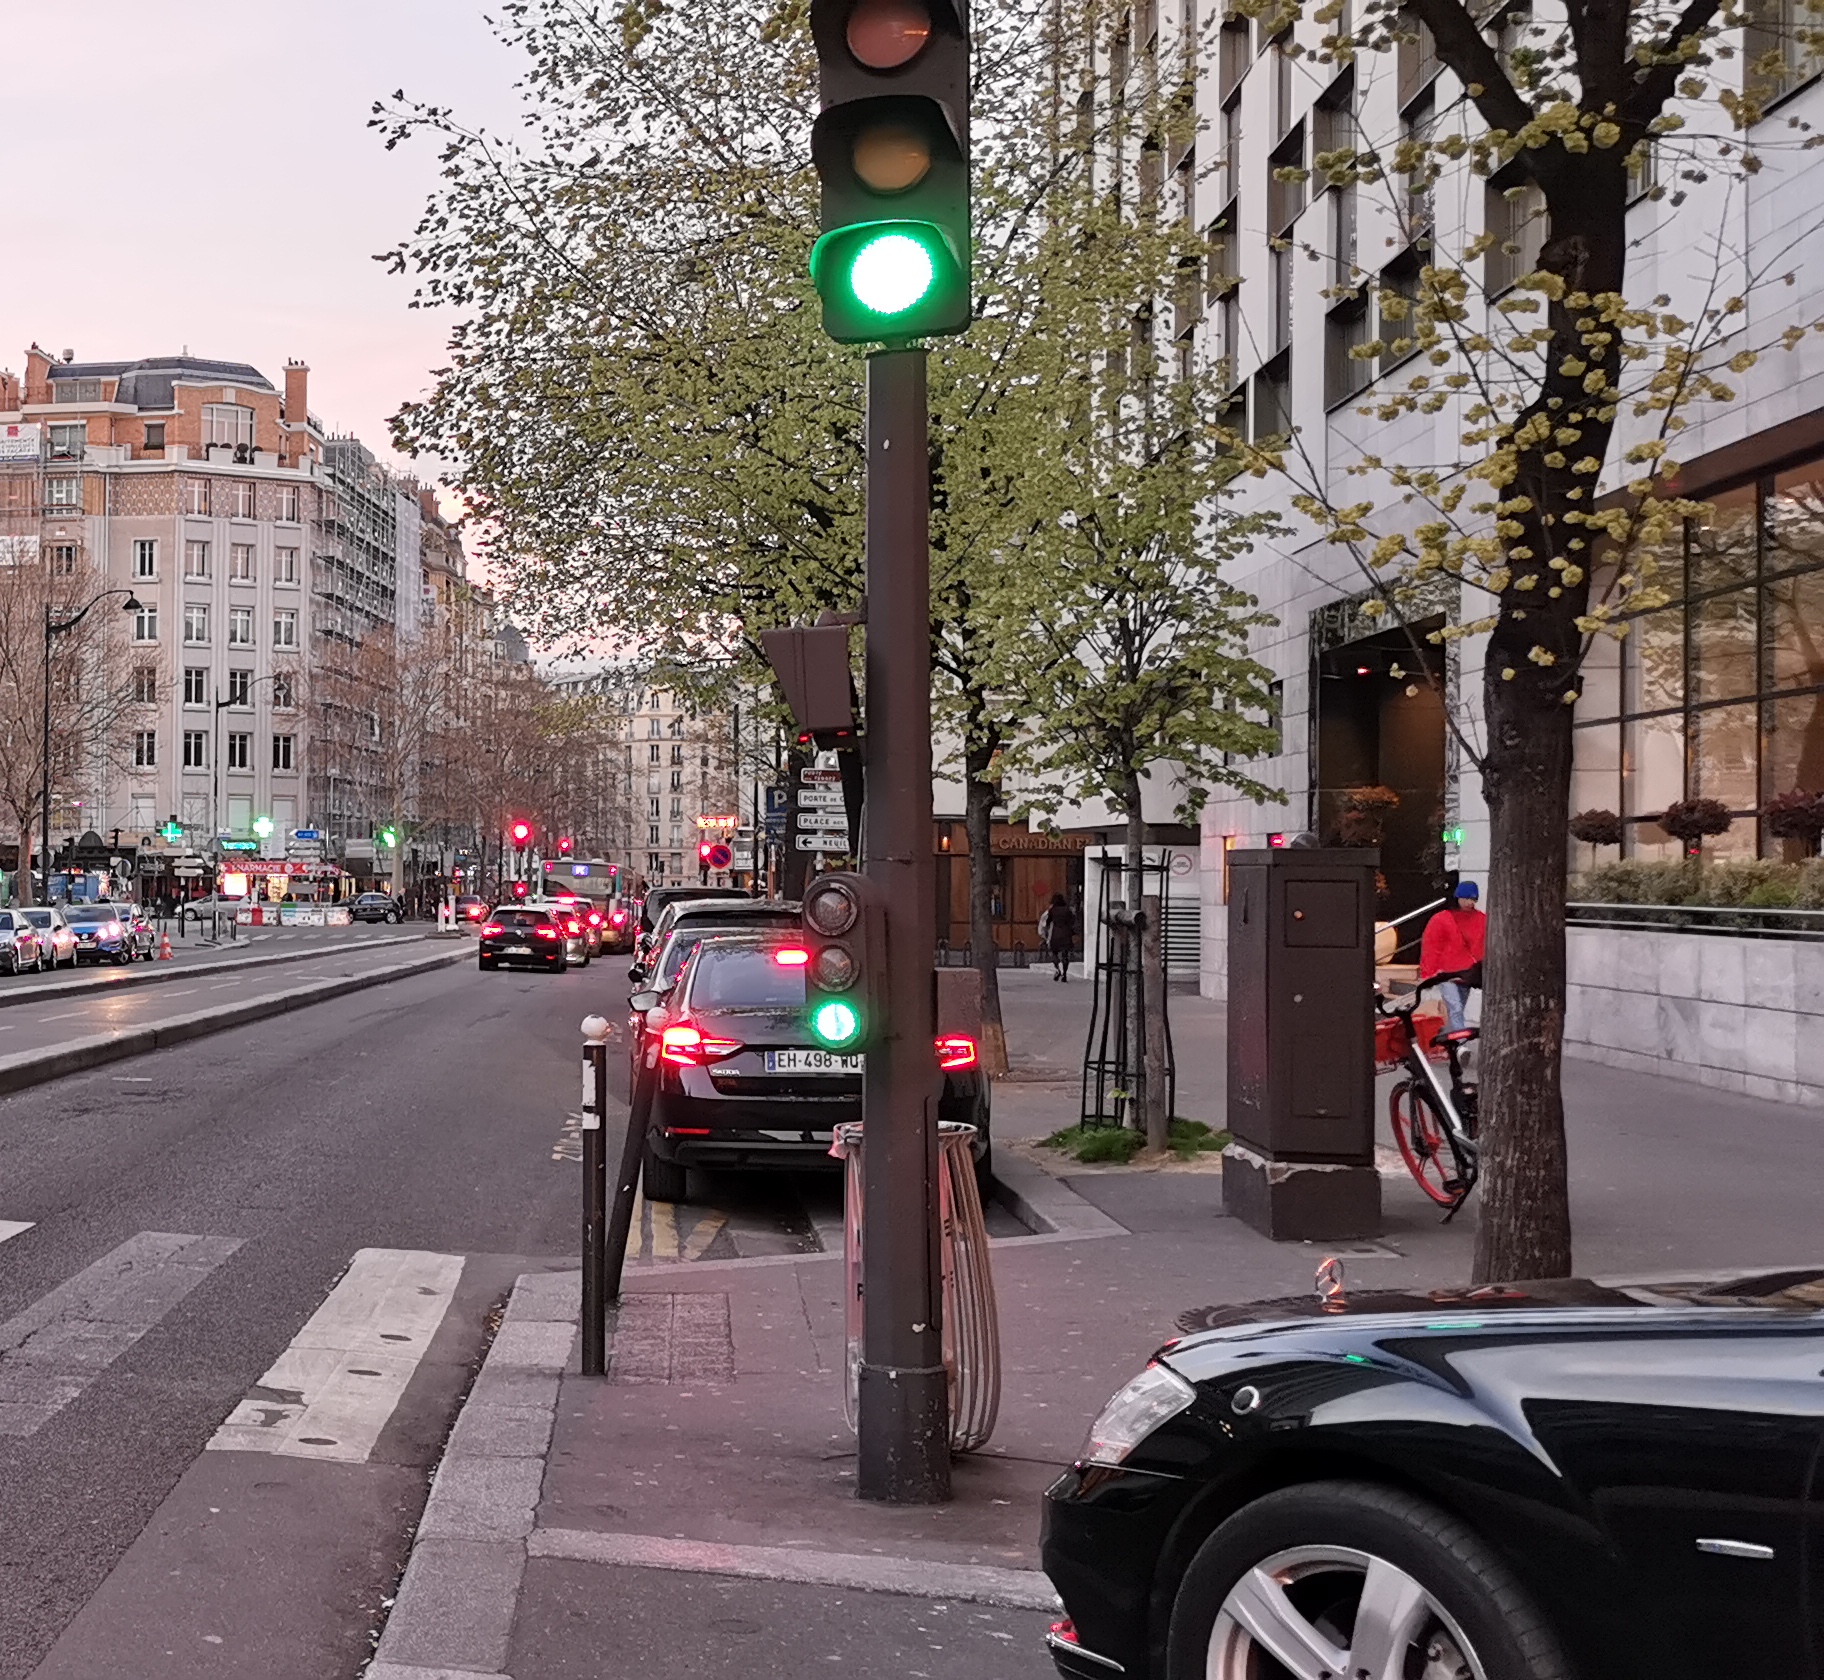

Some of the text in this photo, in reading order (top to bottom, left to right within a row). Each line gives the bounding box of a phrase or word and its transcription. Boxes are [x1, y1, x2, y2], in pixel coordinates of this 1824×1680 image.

[803, 795, 828, 803] PORTE
[803, 817, 830, 825] PLACE
[999, 837, 1072, 850] CANADIAN
